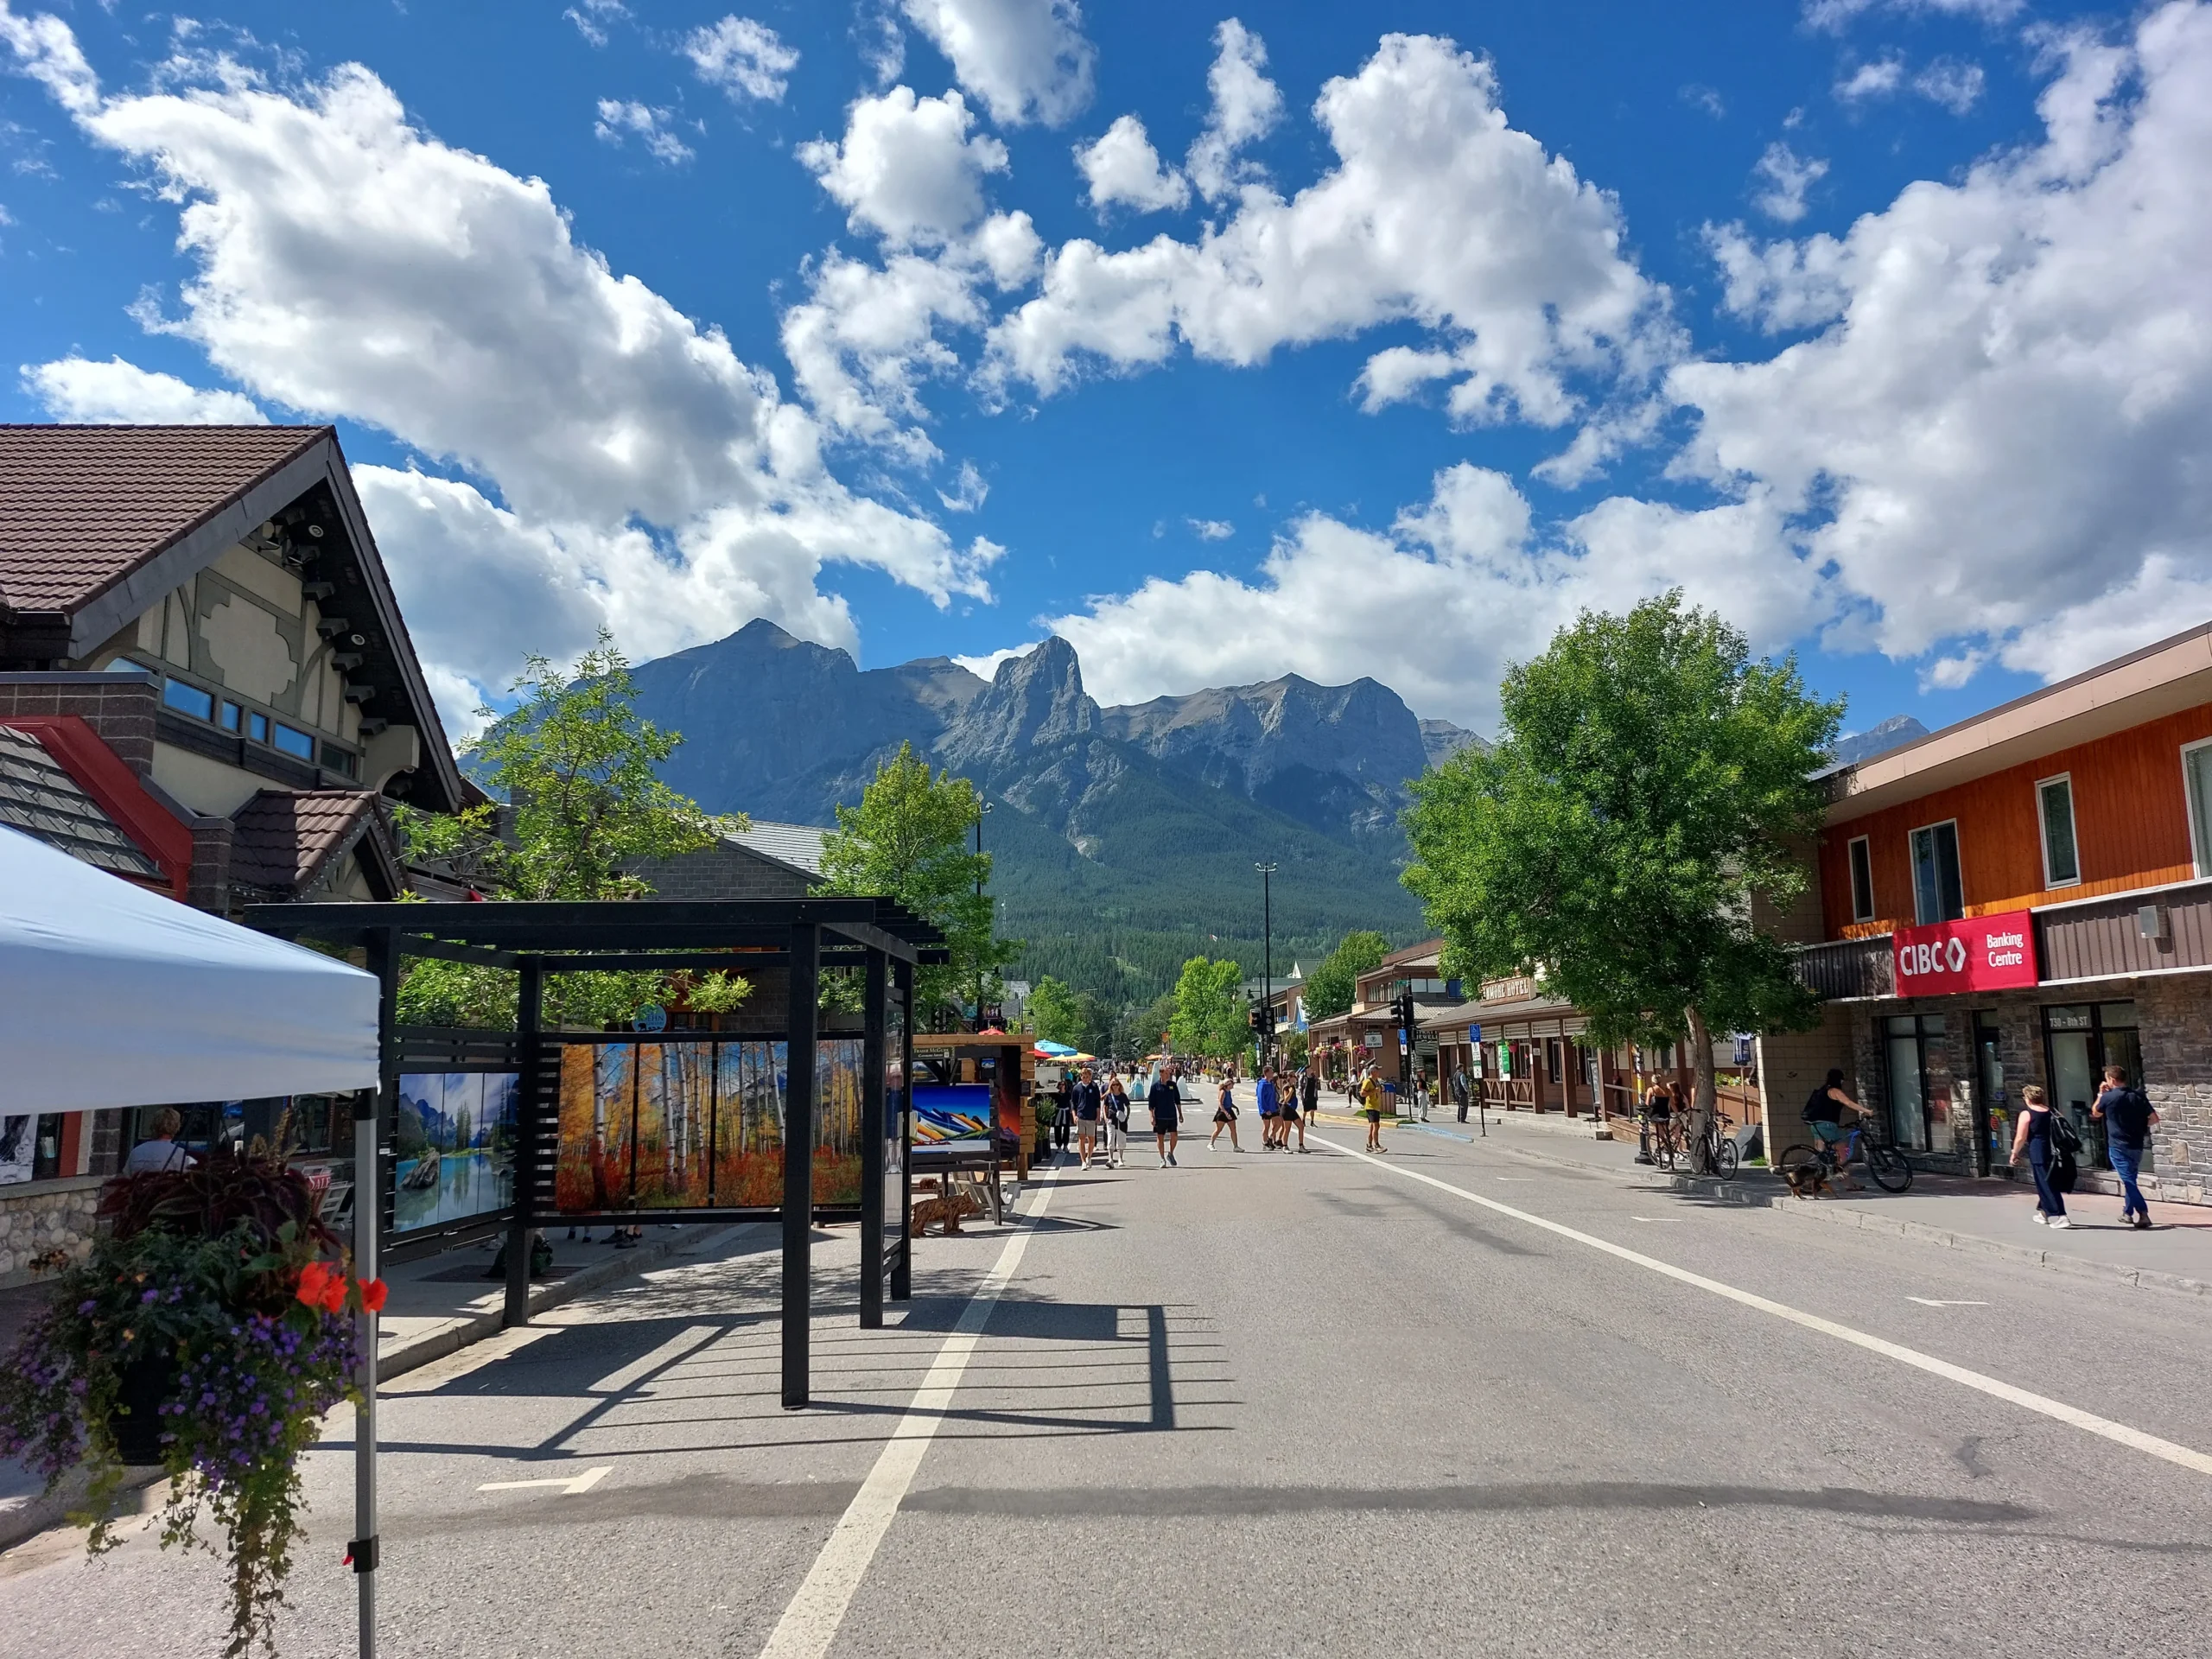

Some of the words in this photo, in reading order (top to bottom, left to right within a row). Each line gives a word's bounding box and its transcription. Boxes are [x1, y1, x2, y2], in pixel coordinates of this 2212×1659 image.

[1986, 931, 2023, 949] Banking
[1900, 941, 1944, 976] CIBC
[1988, 950, 2023, 967] Centre
[1506, 979, 1529, 996] HOTEL
[2049, 1017, 2062, 1027] 730
[2079, 1015, 2088, 1026] ST
[308, 1175, 332, 1191] SALE
